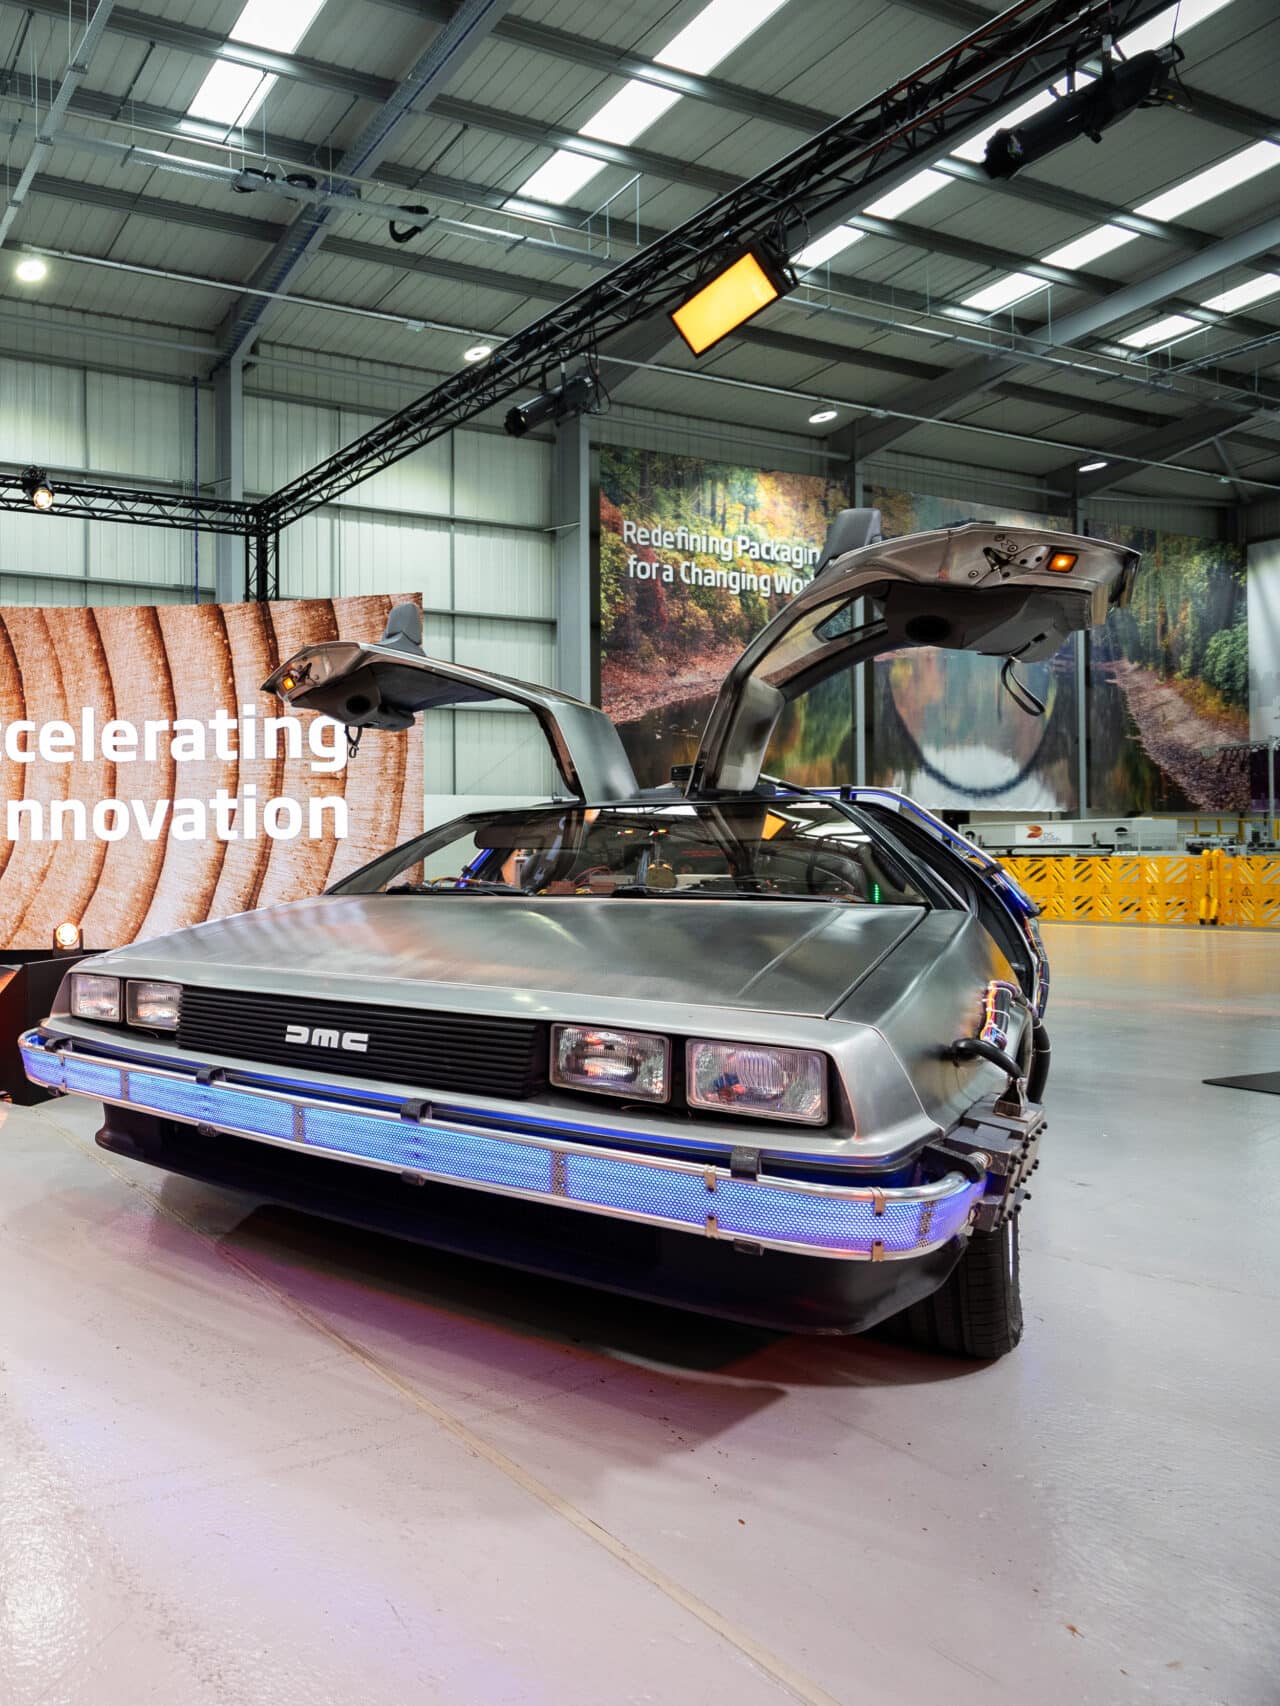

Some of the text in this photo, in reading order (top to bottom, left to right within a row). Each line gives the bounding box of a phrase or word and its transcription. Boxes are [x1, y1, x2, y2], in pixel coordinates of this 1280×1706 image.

[623, 520, 820, 569] Redefining Packagin
[628, 554, 659, 580] for
[663, 565, 674, 582] a
[680, 561, 770, 597] Changing
